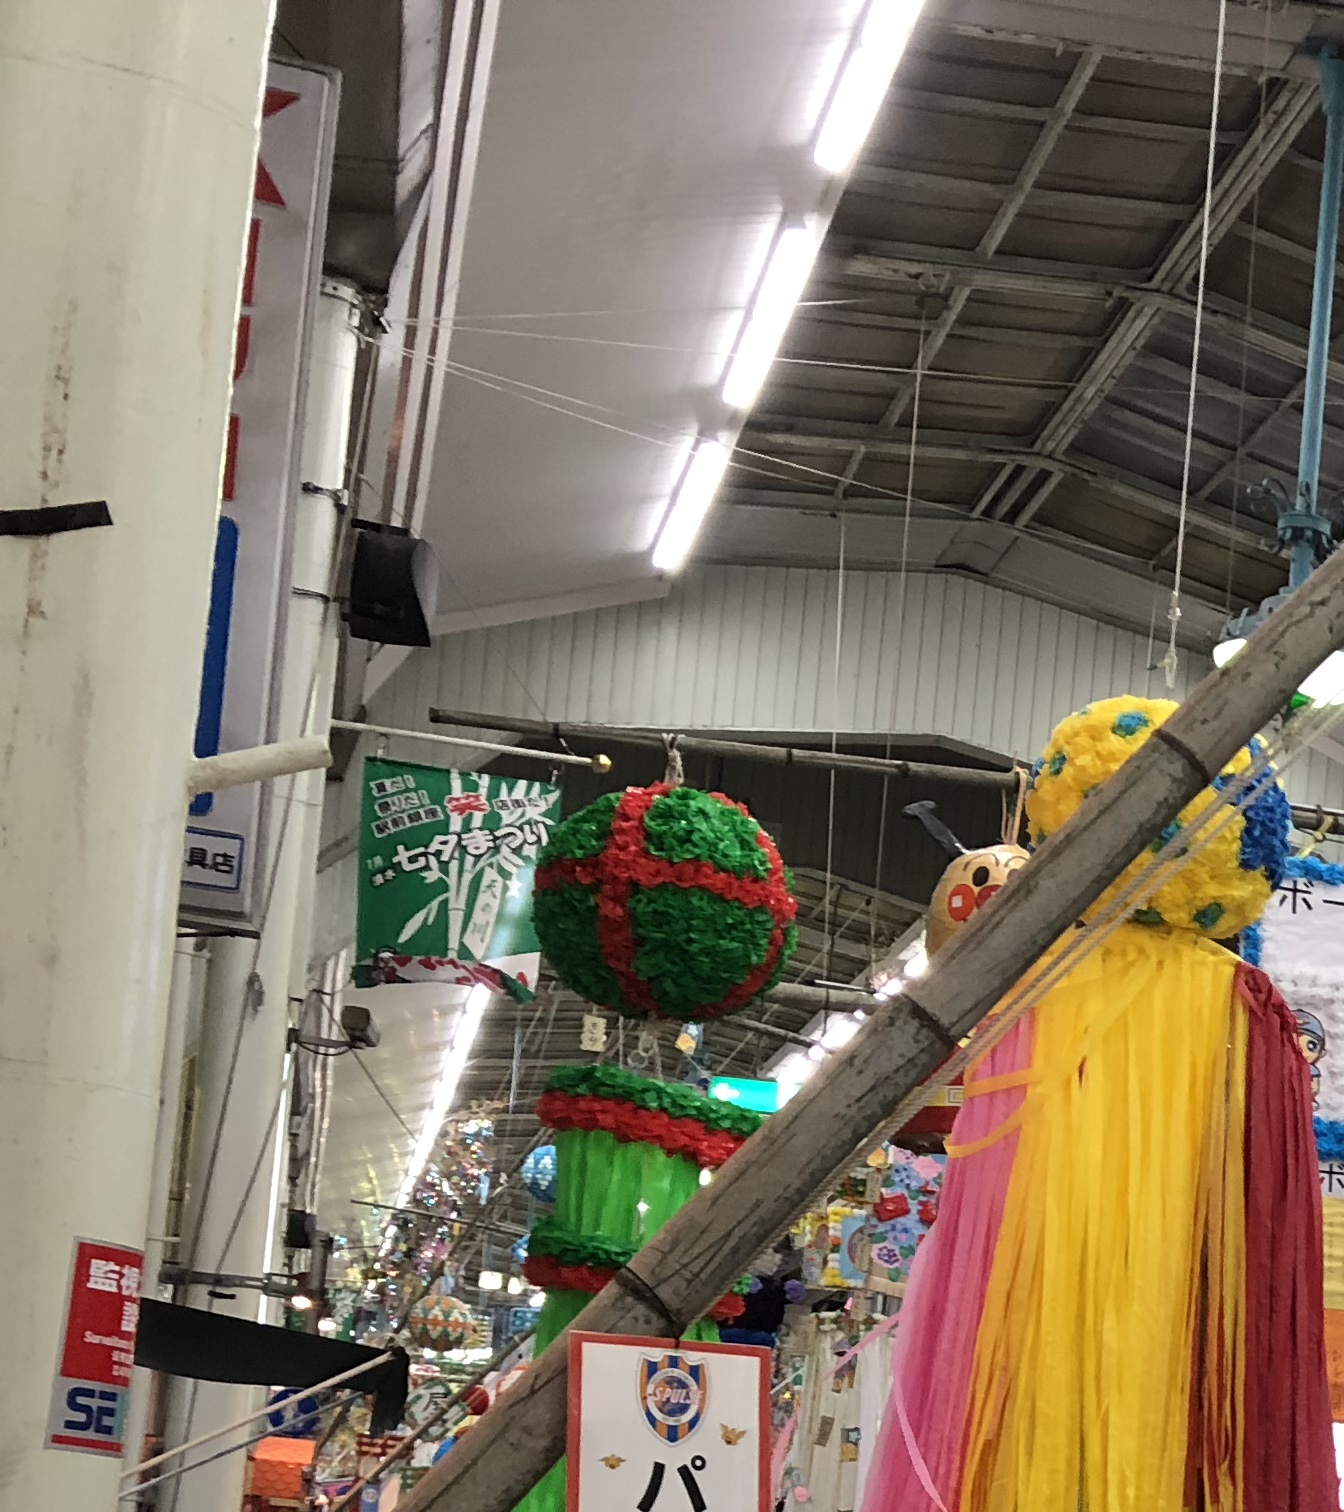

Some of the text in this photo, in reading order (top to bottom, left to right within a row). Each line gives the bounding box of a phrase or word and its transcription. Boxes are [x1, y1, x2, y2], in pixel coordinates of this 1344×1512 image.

[392, 823, 550, 872] 七夕まつり
